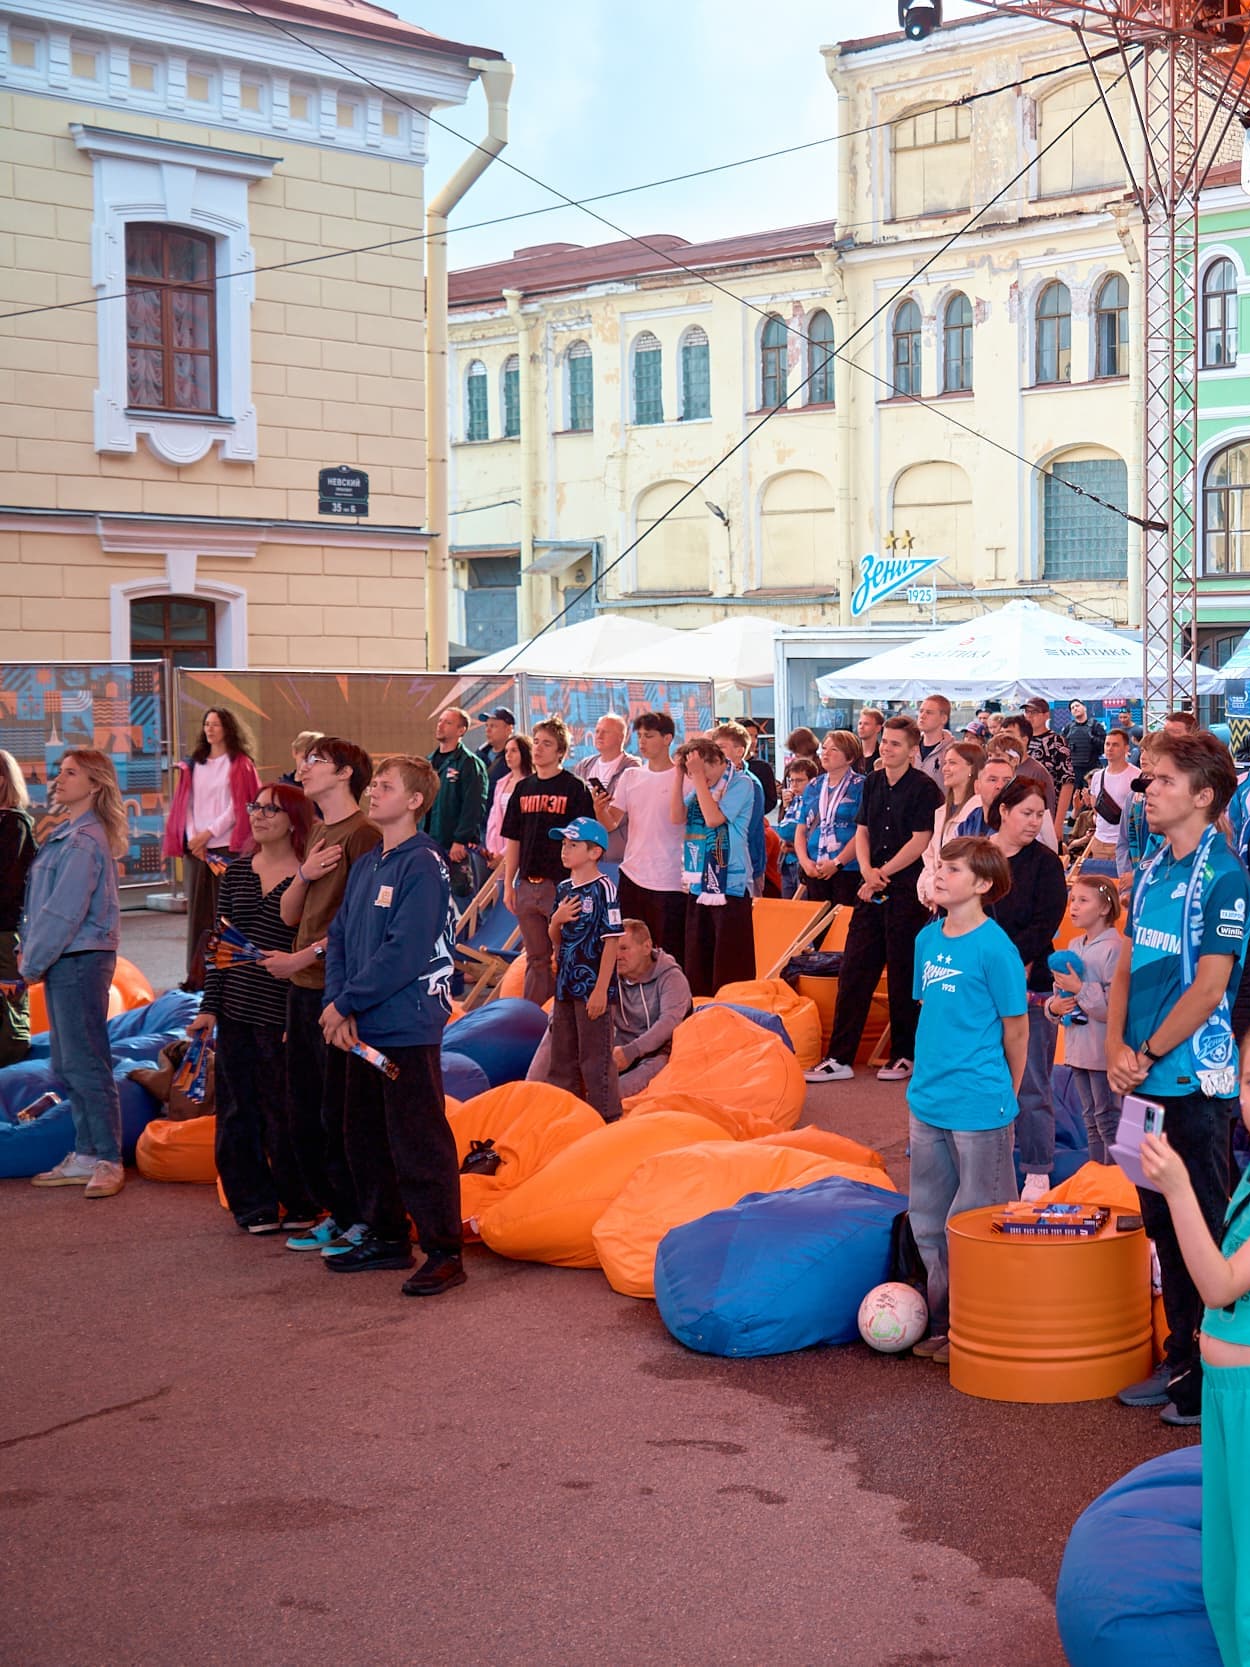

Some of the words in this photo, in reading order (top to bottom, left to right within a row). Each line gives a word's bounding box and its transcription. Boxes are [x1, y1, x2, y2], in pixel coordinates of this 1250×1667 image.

[327, 477, 360, 487] НЕВСКИЙ
[332, 503, 341, 512] 35
[852, 555, 941, 615] Зенит
[908, 589, 932, 602] 1925
[1058, 648, 1132, 657] БАЛТИКА
[1221, 926, 1243, 937] Winli
[1135, 926, 1181, 955] ГАЗПРОМ
[942, 983, 956, 993] 1925
